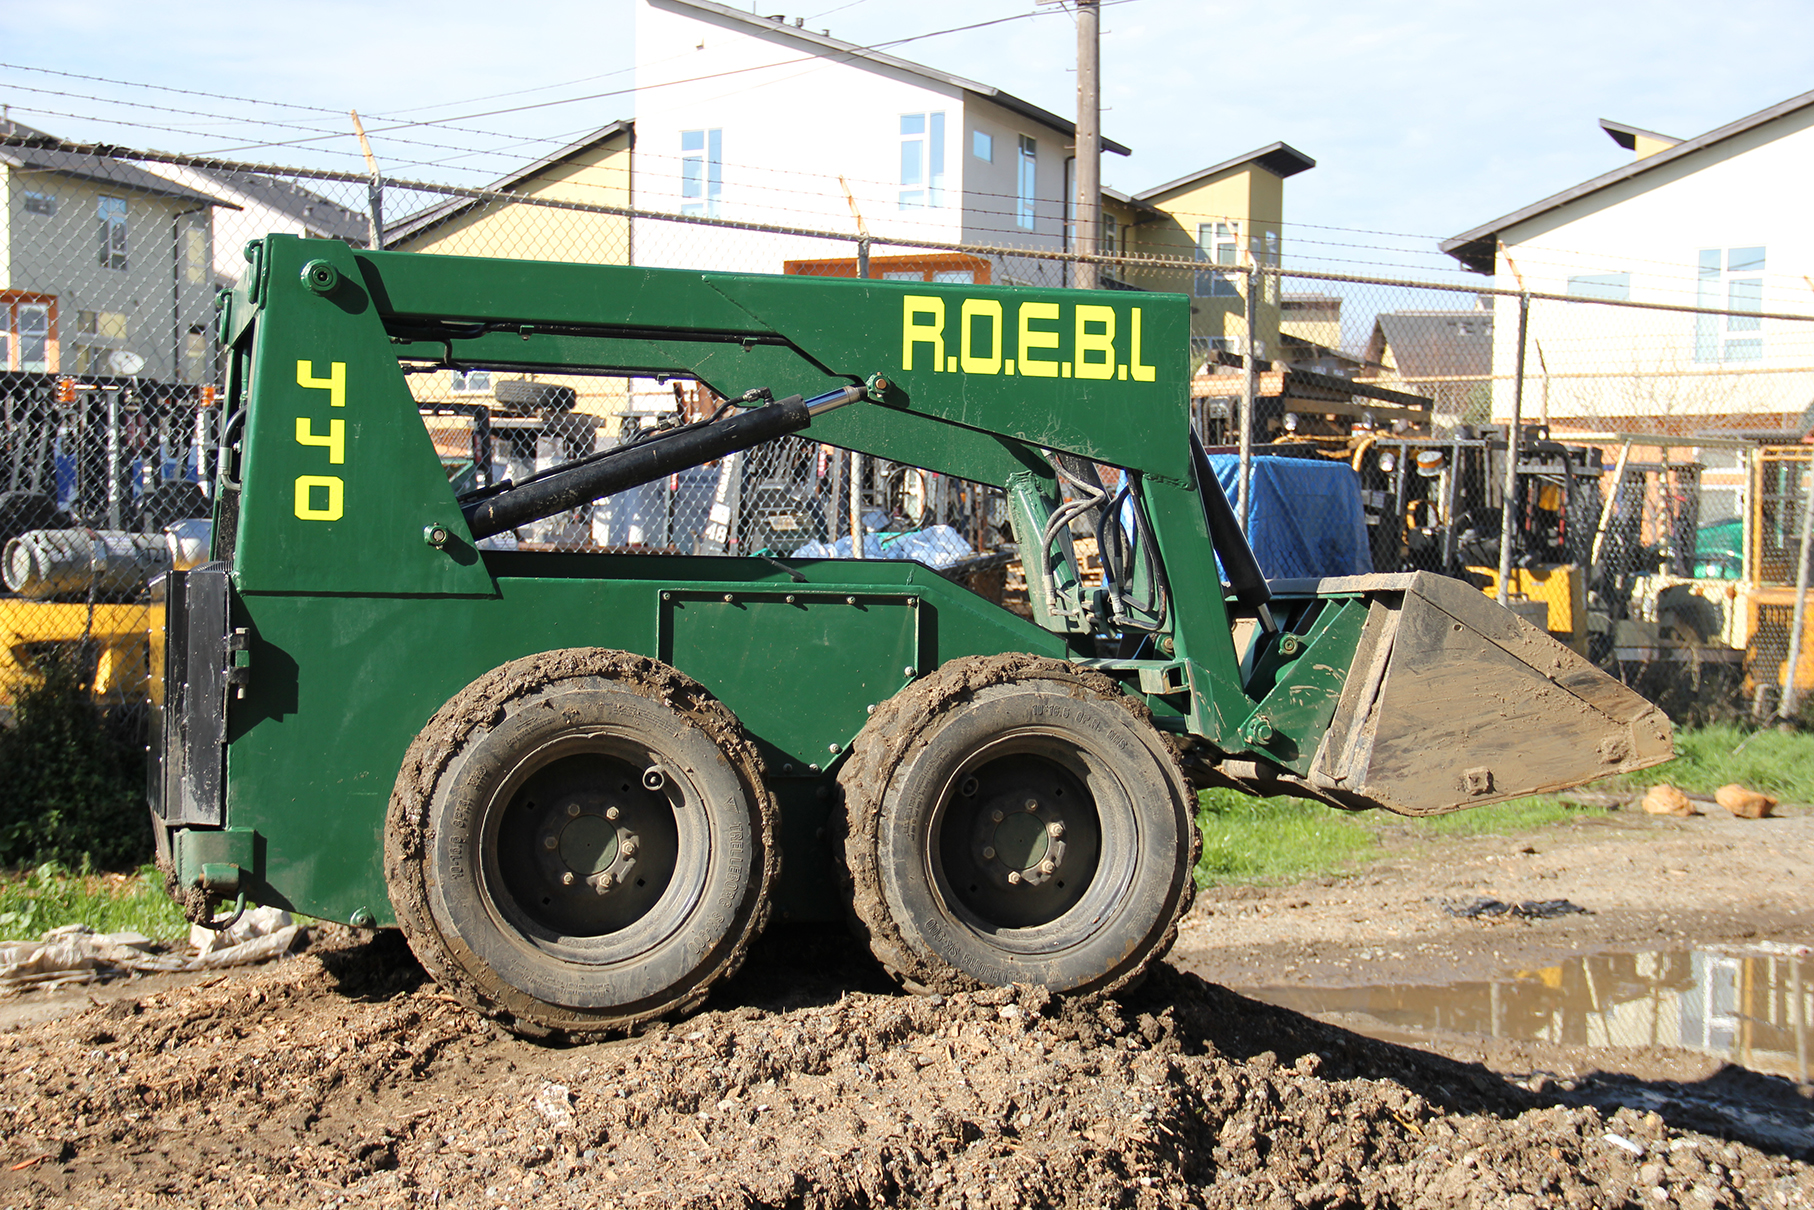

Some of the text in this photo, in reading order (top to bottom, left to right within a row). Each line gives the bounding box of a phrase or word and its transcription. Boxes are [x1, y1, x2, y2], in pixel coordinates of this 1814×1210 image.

[902, 294, 1156, 382] R.O.E.B.L
[294, 359, 346, 521] 440
[716, 454, 735, 503] KOMATS
[705, 522, 728, 544] 48
[688, 822, 744, 955] TRELLEBORG SK-900
[925, 917, 961, 959] SK-900
